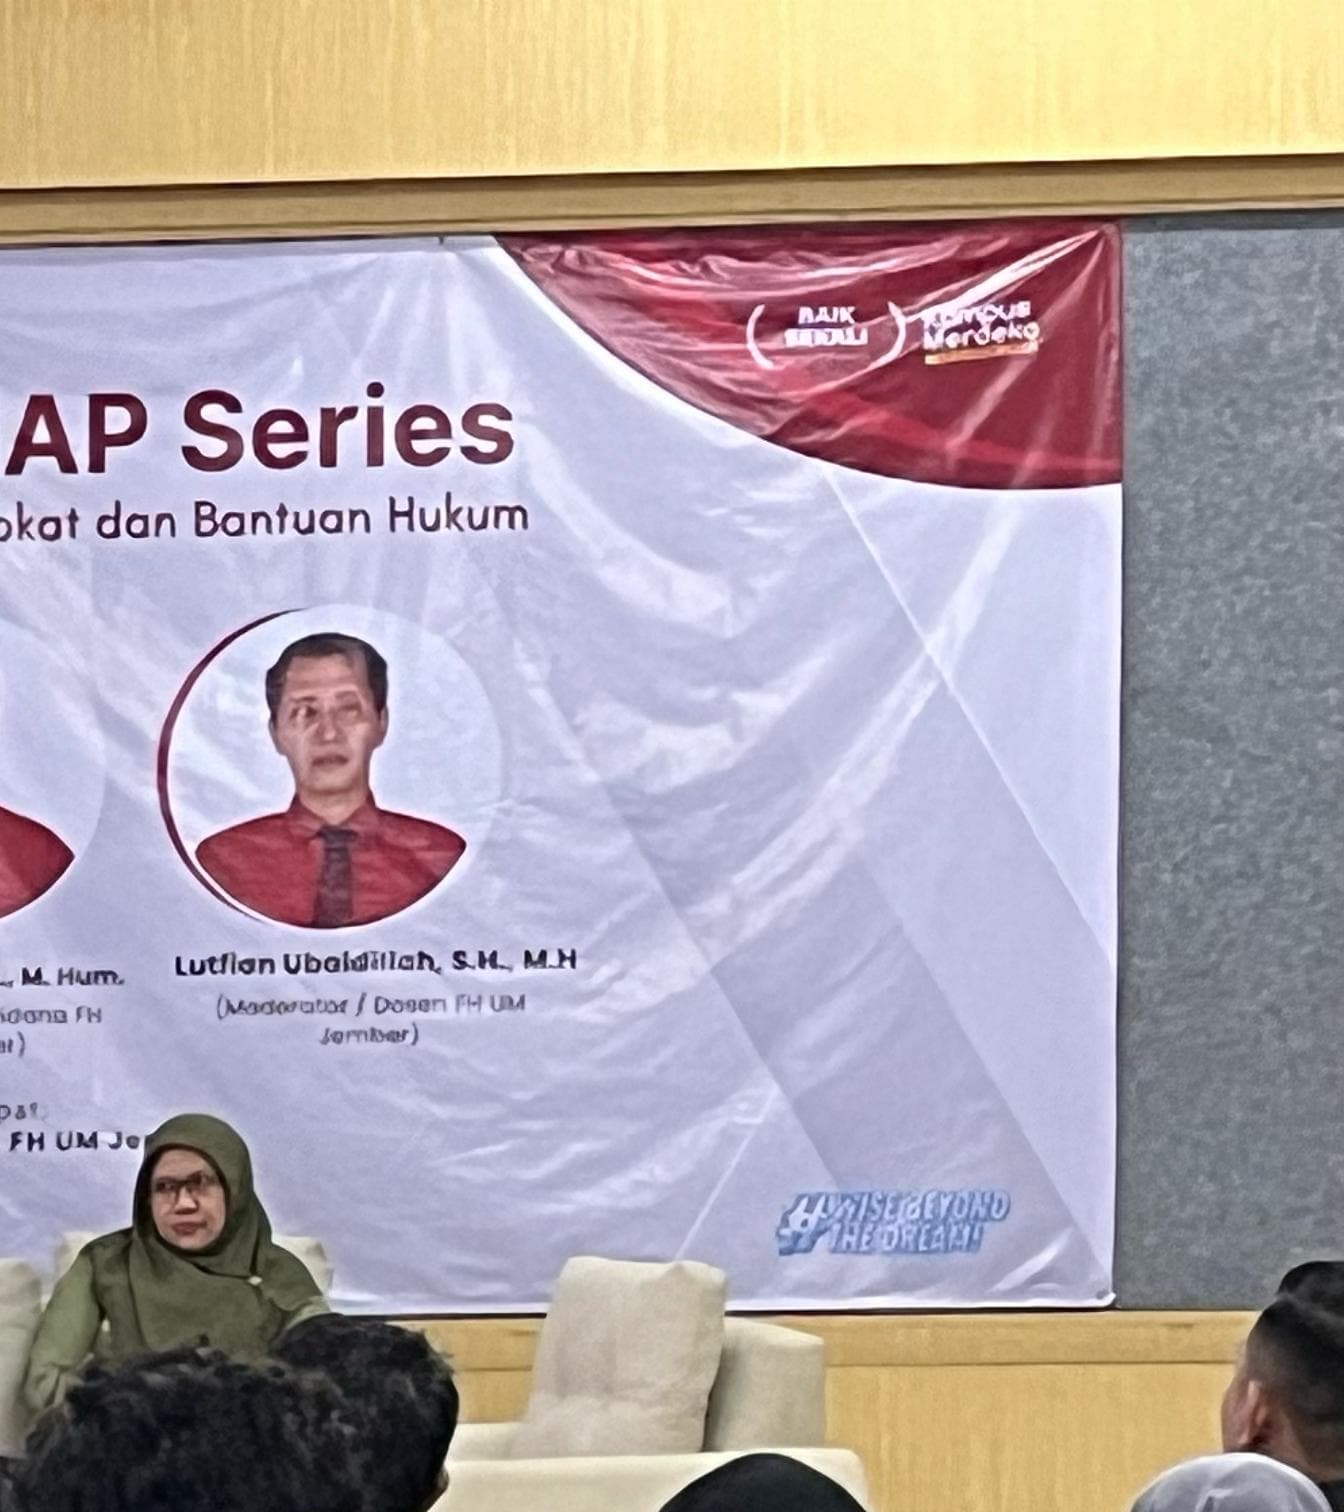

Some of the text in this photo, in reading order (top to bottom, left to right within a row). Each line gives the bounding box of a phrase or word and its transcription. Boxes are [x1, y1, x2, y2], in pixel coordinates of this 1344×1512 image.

[181, 382, 514, 474] Series
[96, 501, 176, 540] dan
[194, 500, 371, 540] Bantuan
[388, 492, 530, 532] Hukum
[9, 1132, 45, 1152] FH
